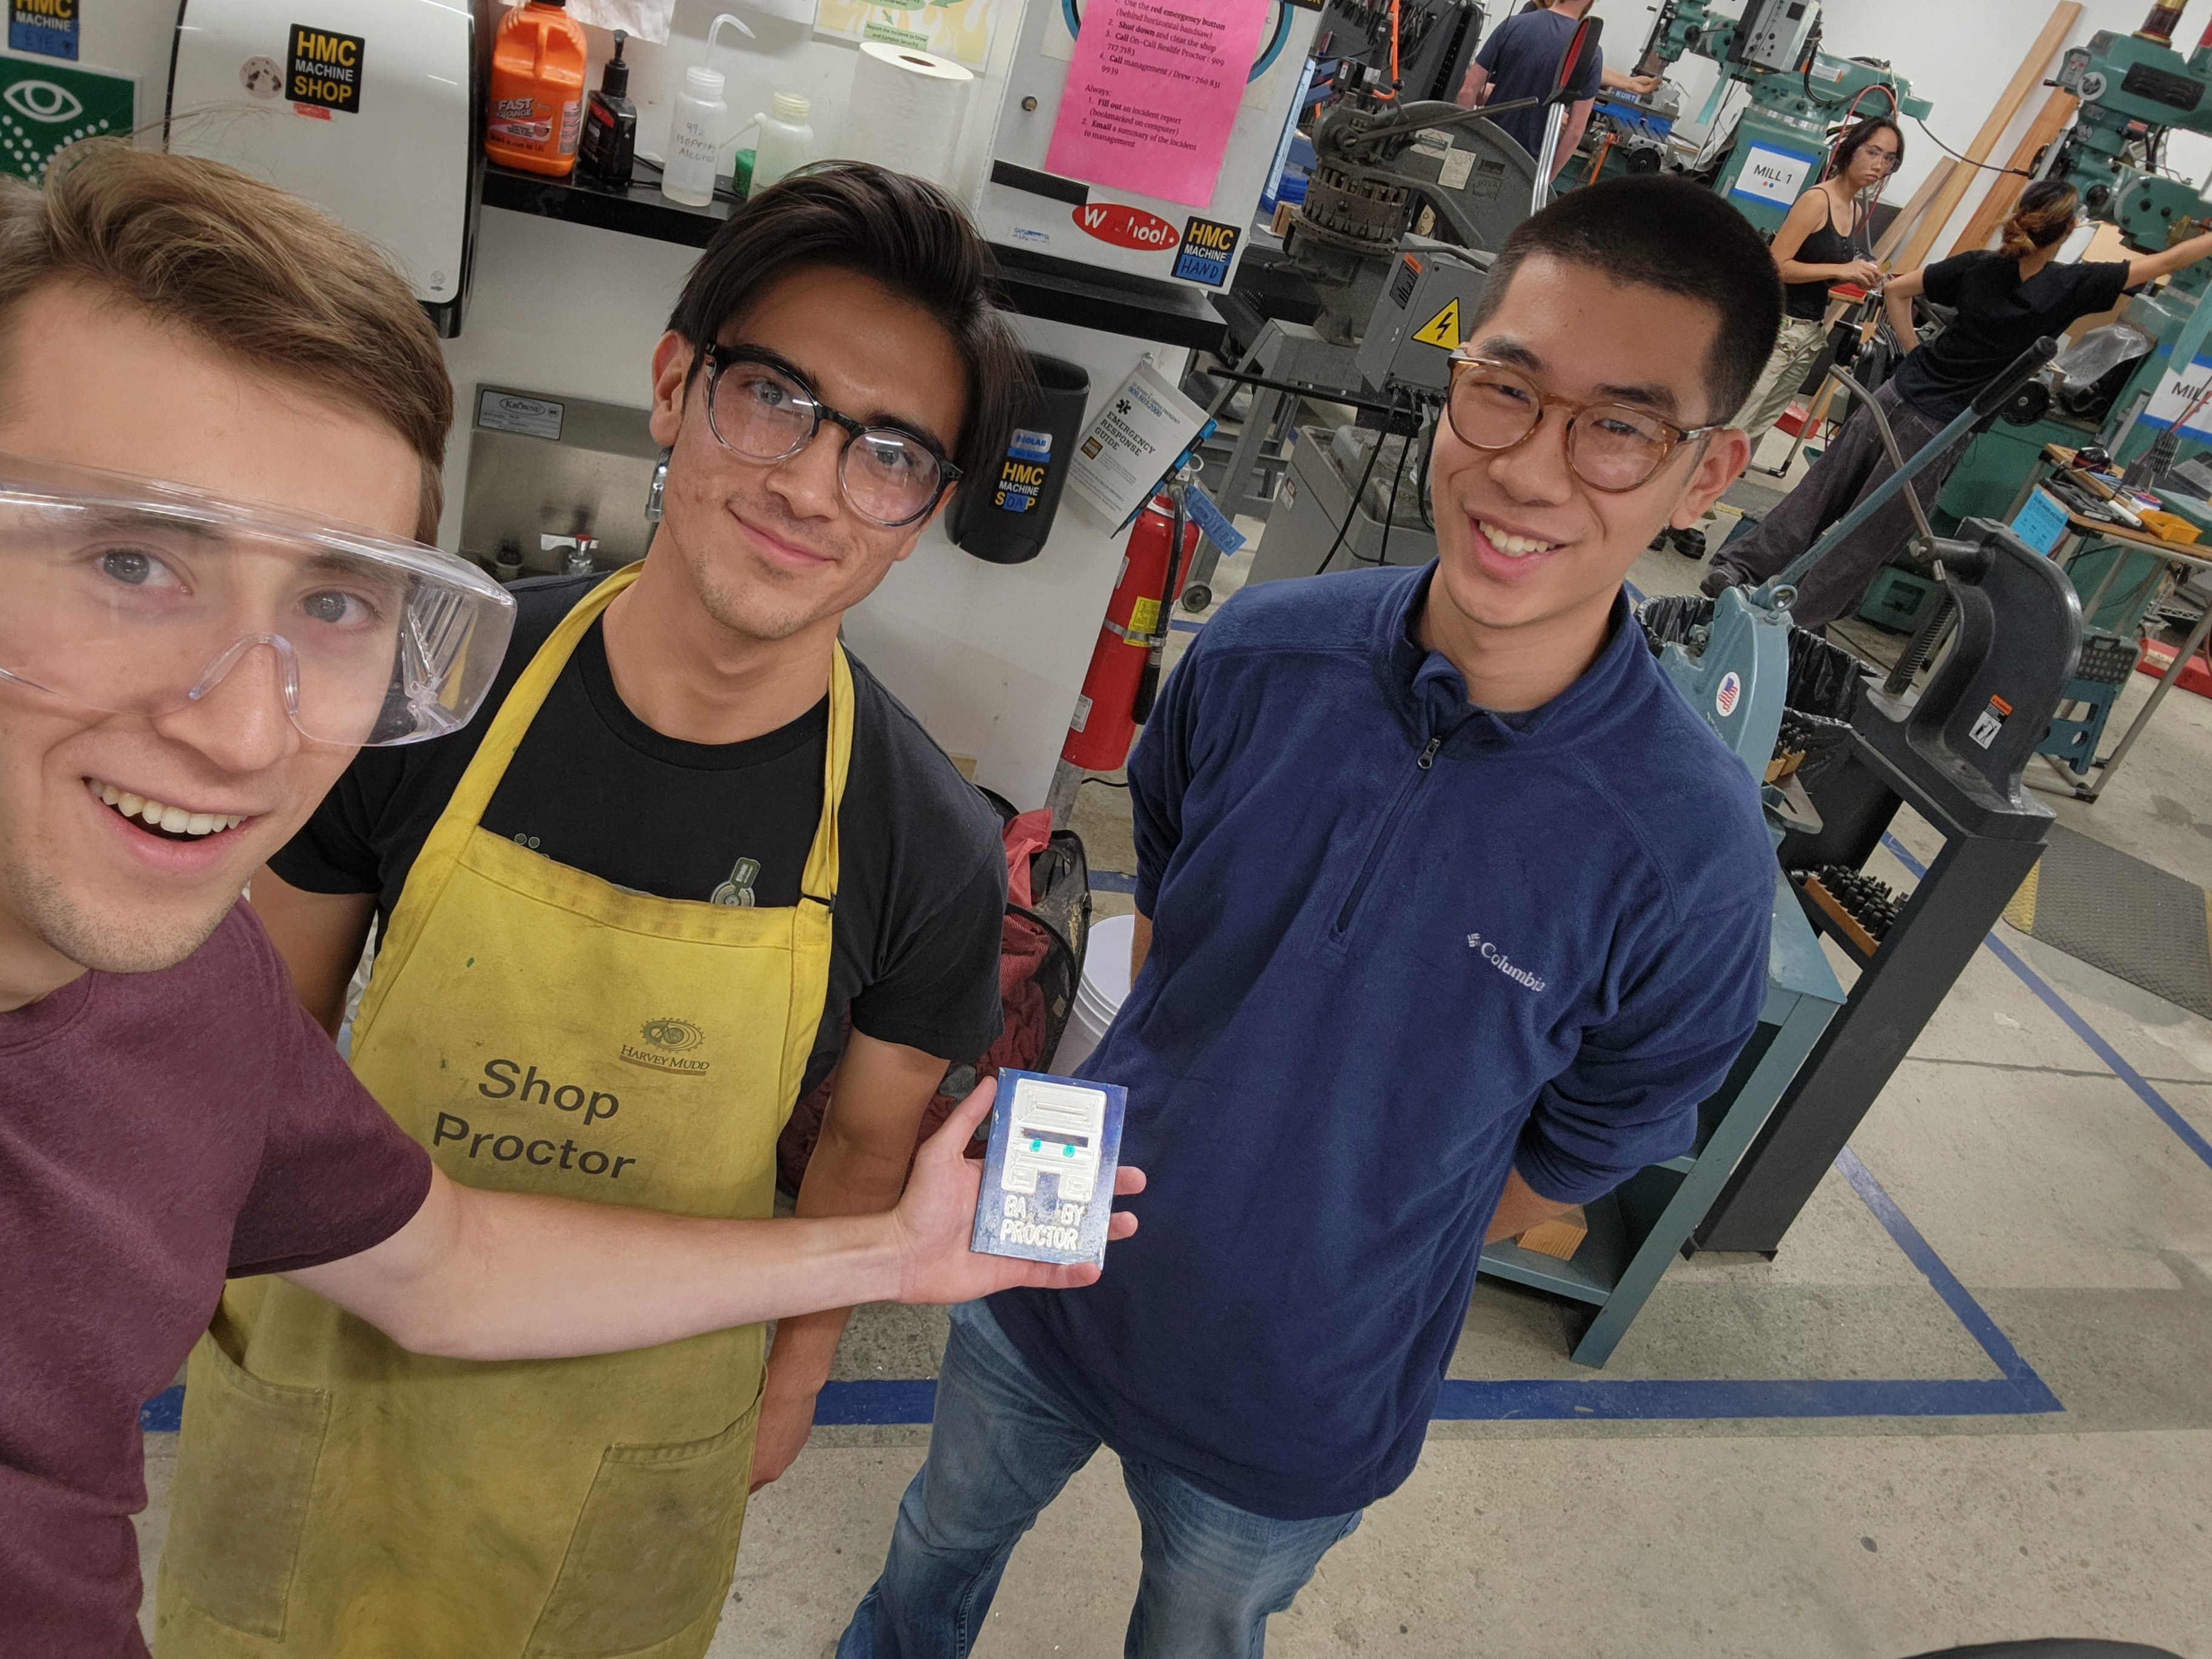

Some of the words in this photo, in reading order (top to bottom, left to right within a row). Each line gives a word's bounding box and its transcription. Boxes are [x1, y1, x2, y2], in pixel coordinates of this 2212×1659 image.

[16, 10, 72, 32] MACHINE
[1116, 8, 1143, 21] (behind
[1144, 15, 1179, 31] horizontal
[1180, 23, 1213, 39] bandsaw)
[1138, 1, 1150, 10] the
[1163, 9, 1201, 25] emergency
[1202, 17, 1225, 30] button
[891, 30, 909, 38] incident
[900, 39, 919, 47] Security
[1118, 21, 1135, 31] Shut
[1135, 25, 1155, 36] down
[1156, 32, 1169, 40] and
[1170, 34, 1187, 45] clear
[1187, 38, 1199, 47] the
[1200, 41, 1216, 54] shop
[297, 31, 356, 66] HMC
[1107, 43, 1119, 52] 717
[1119, 46, 1136, 56] 7183
[1115, 32, 1129, 42] Call
[1130, 36, 1156, 49] On-Call
[1158, 42, 1181, 55] Reslife
[1181, 48, 1207, 61] Proctor
[1211, 57, 1225, 67] 909
[295, 59, 354, 82] MACHINE
[1101, 65, 1119, 76] 9939
[1109, 55, 1122, 64] Call
[1123, 59, 1168, 75] management
[1173, 70, 1191, 81] Drew
[1195, 77, 1208, 85] 760
[1209, 80, 1221, 89] 831
[294, 75, 352, 103] SHOP
[1085, 84, 1111, 96] Always:
[1615, 90, 1636, 102] KURT
[497, 109, 532, 118] ORANGE
[498, 98, 534, 111] FAST
[1097, 98, 1110, 107] Fill
[1131, 107, 1159, 119] incident
[1160, 115, 1181, 125] report
[1090, 108, 1134, 125] (bookmarked
[1144, 122, 1179, 136] computer)
[1091, 120, 1112, 131] Email
[1117, 127, 1149, 140] summary
[1150, 133, 1158, 142] of
[1158, 135, 1169, 144] the
[1170, 137, 1197, 151] incident
[1091, 132, 1136, 148] management
[1754, 164, 1781, 182] MILL
[1786, 174, 1792, 184] 1
[1188, 222, 1234, 250] HMC
[1184, 244, 1227, 263] MACHINE
[1181, 258, 1219, 279] HAND
[1094, 426, 1120, 451] GUIDE
[1100, 418, 1142, 457] RESPONSE
[1106, 411, 1156, 455] EMERGENCY
[1002, 461, 1044, 486] HMC
[999, 480, 1040, 496] MACHINE
[1481, 942, 1546, 991] Columbia
[620, 1044, 669, 1065] HARVEY
[669, 1057, 709, 1070] MUDD
[478, 1059, 619, 1126] Shop
[433, 1111, 636, 1179] Proctor
[1004, 1194, 1026, 1219] BA
[1061, 1202, 1085, 1226] BY
[1000, 1218, 1078, 1250] PROCTOR
